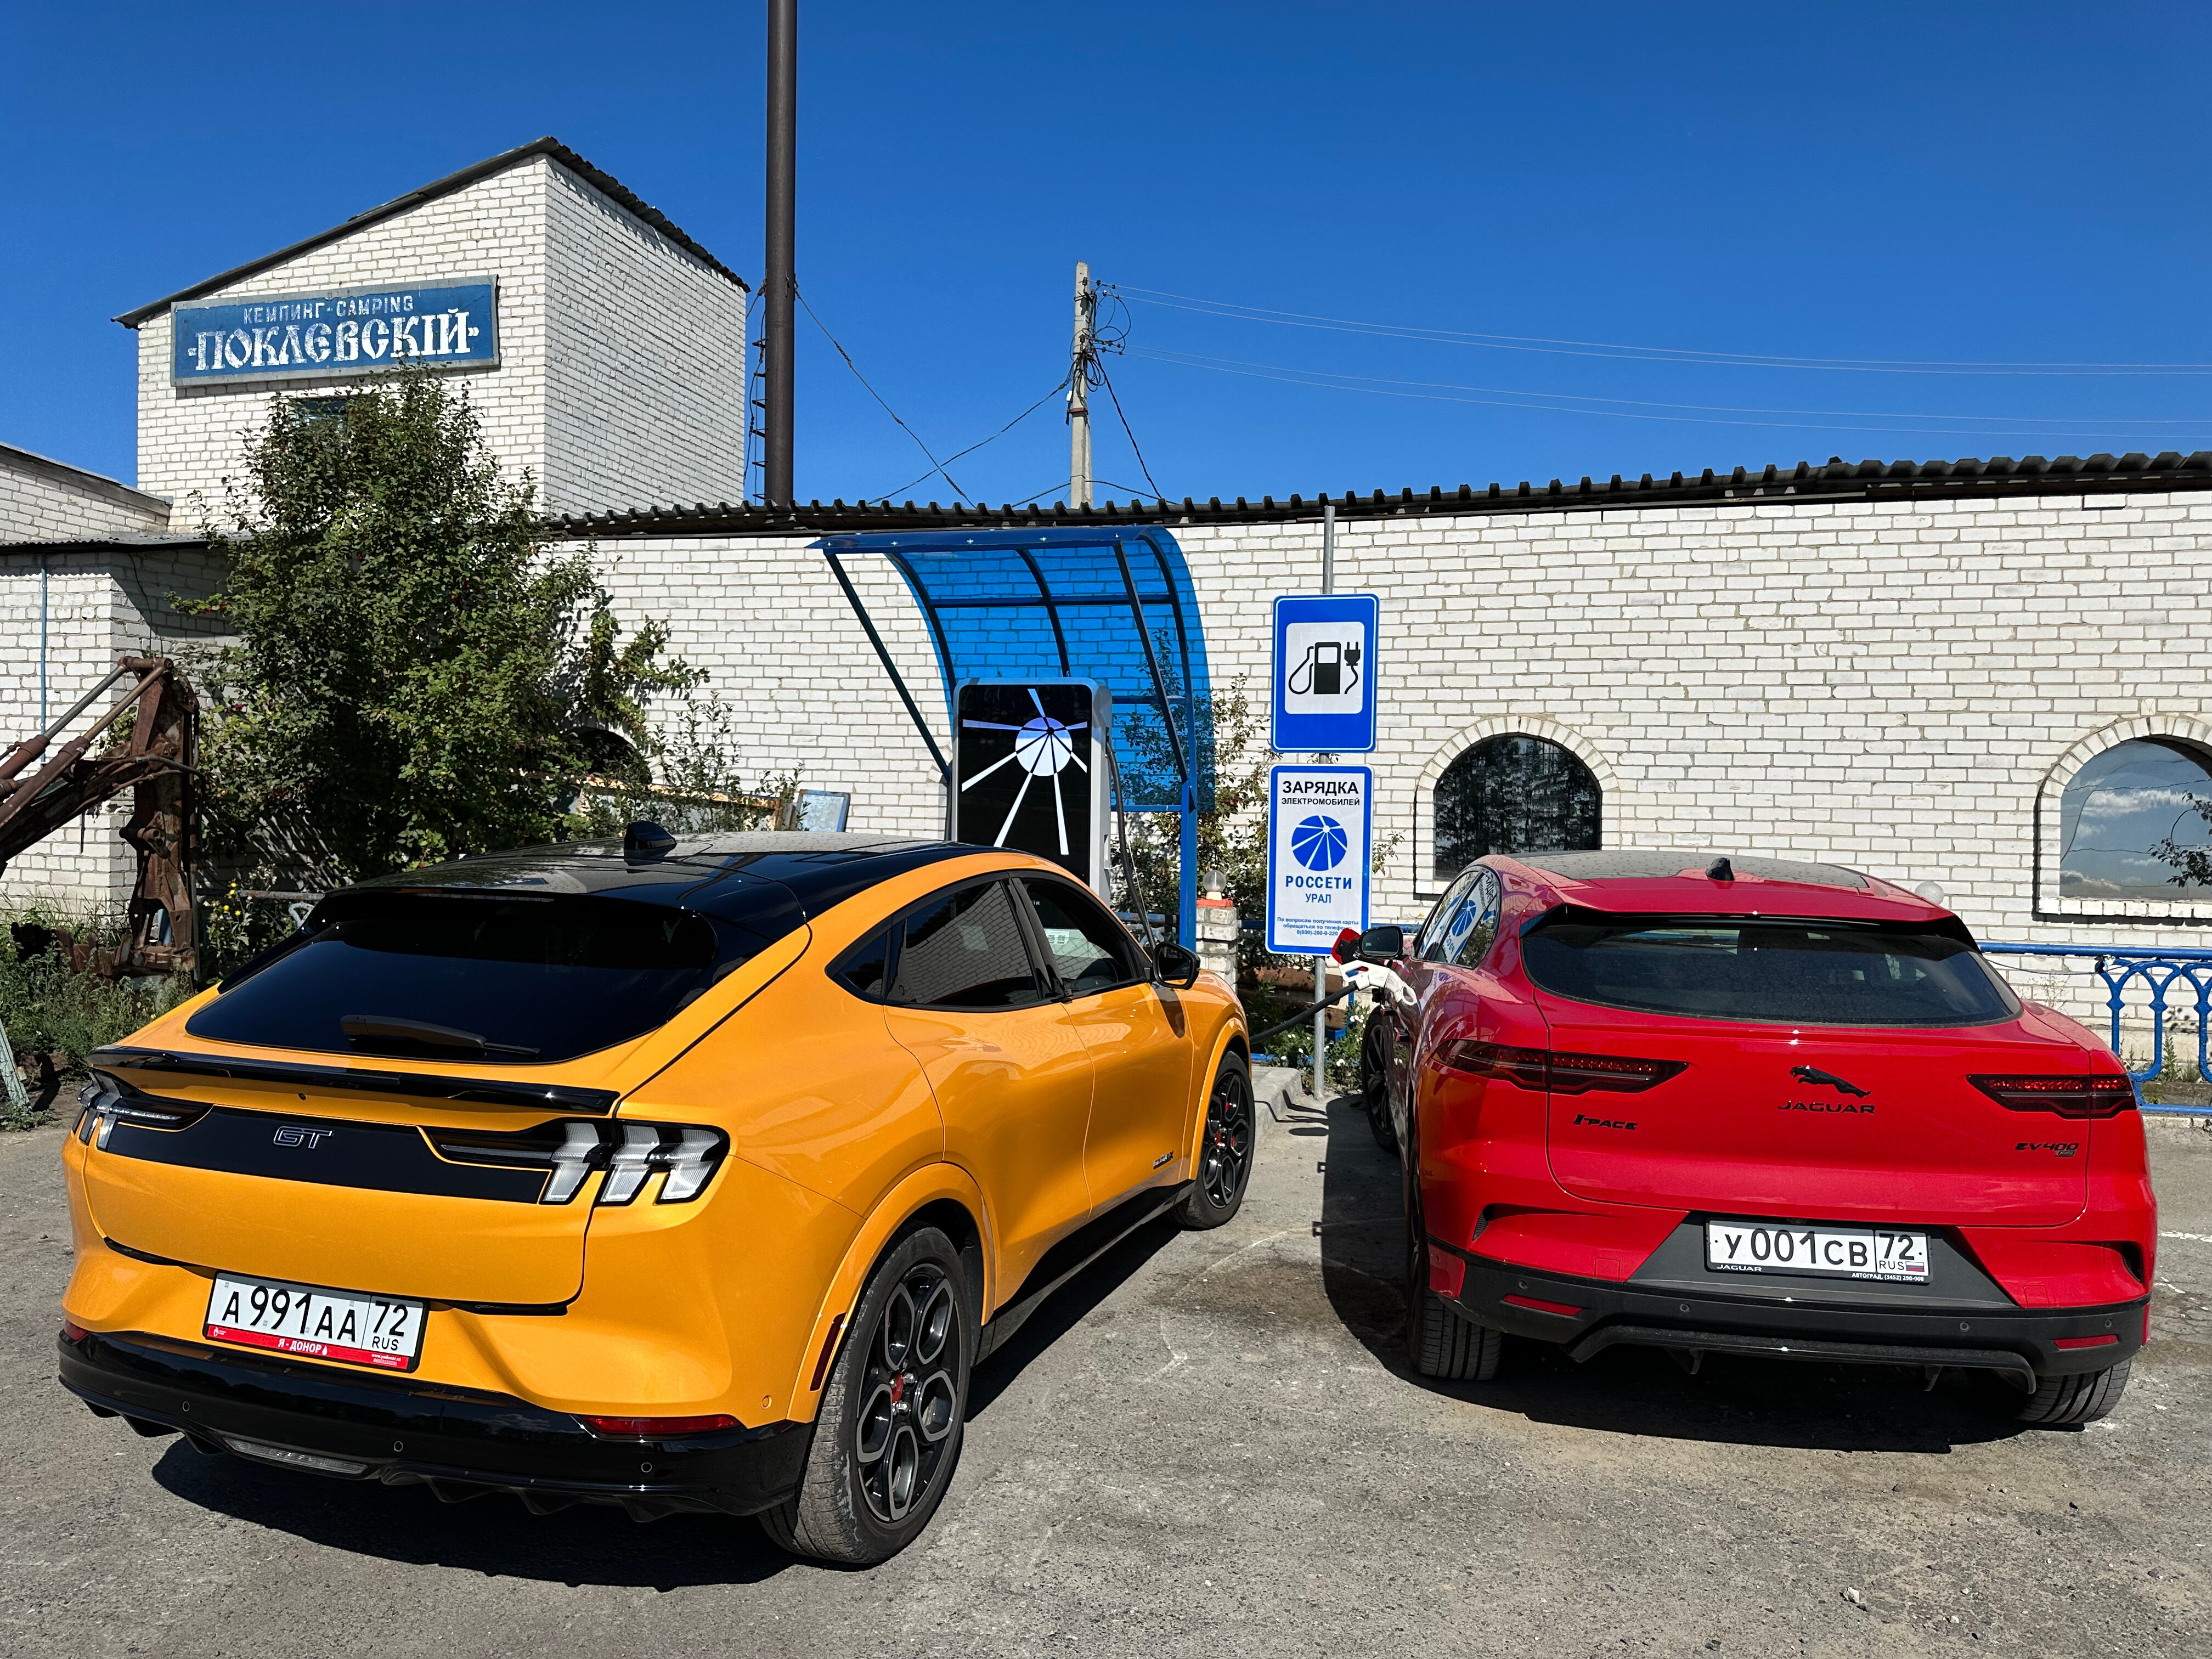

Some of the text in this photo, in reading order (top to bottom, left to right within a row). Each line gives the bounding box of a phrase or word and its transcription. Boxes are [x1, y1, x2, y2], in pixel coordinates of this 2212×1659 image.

[1283, 781, 1359, 797] ЗАРЯДКА
[1282, 797, 1359, 805] ЭЛЕКТРОМОБИЛЕЙ
[1285, 876, 1352, 889] РОССЕТИ
[1305, 893, 1331, 903] УРАЛ
[1778, 1100, 1875, 1114] JAGUAR
[273, 1125, 333, 1149] GT
[2015, 1142, 2079, 1150] EV400
[1878, 1233, 1915, 1261] 72
[1717, 1264, 1763, 1272] JAGUAR
[1879, 1260, 1904, 1270] RUS
[373, 1300, 409, 1337] 72
[278, 1338, 285, 1347] Я
[290, 1340, 322, 1353] ДОНОР
[371, 1336, 399, 1351] RUS
